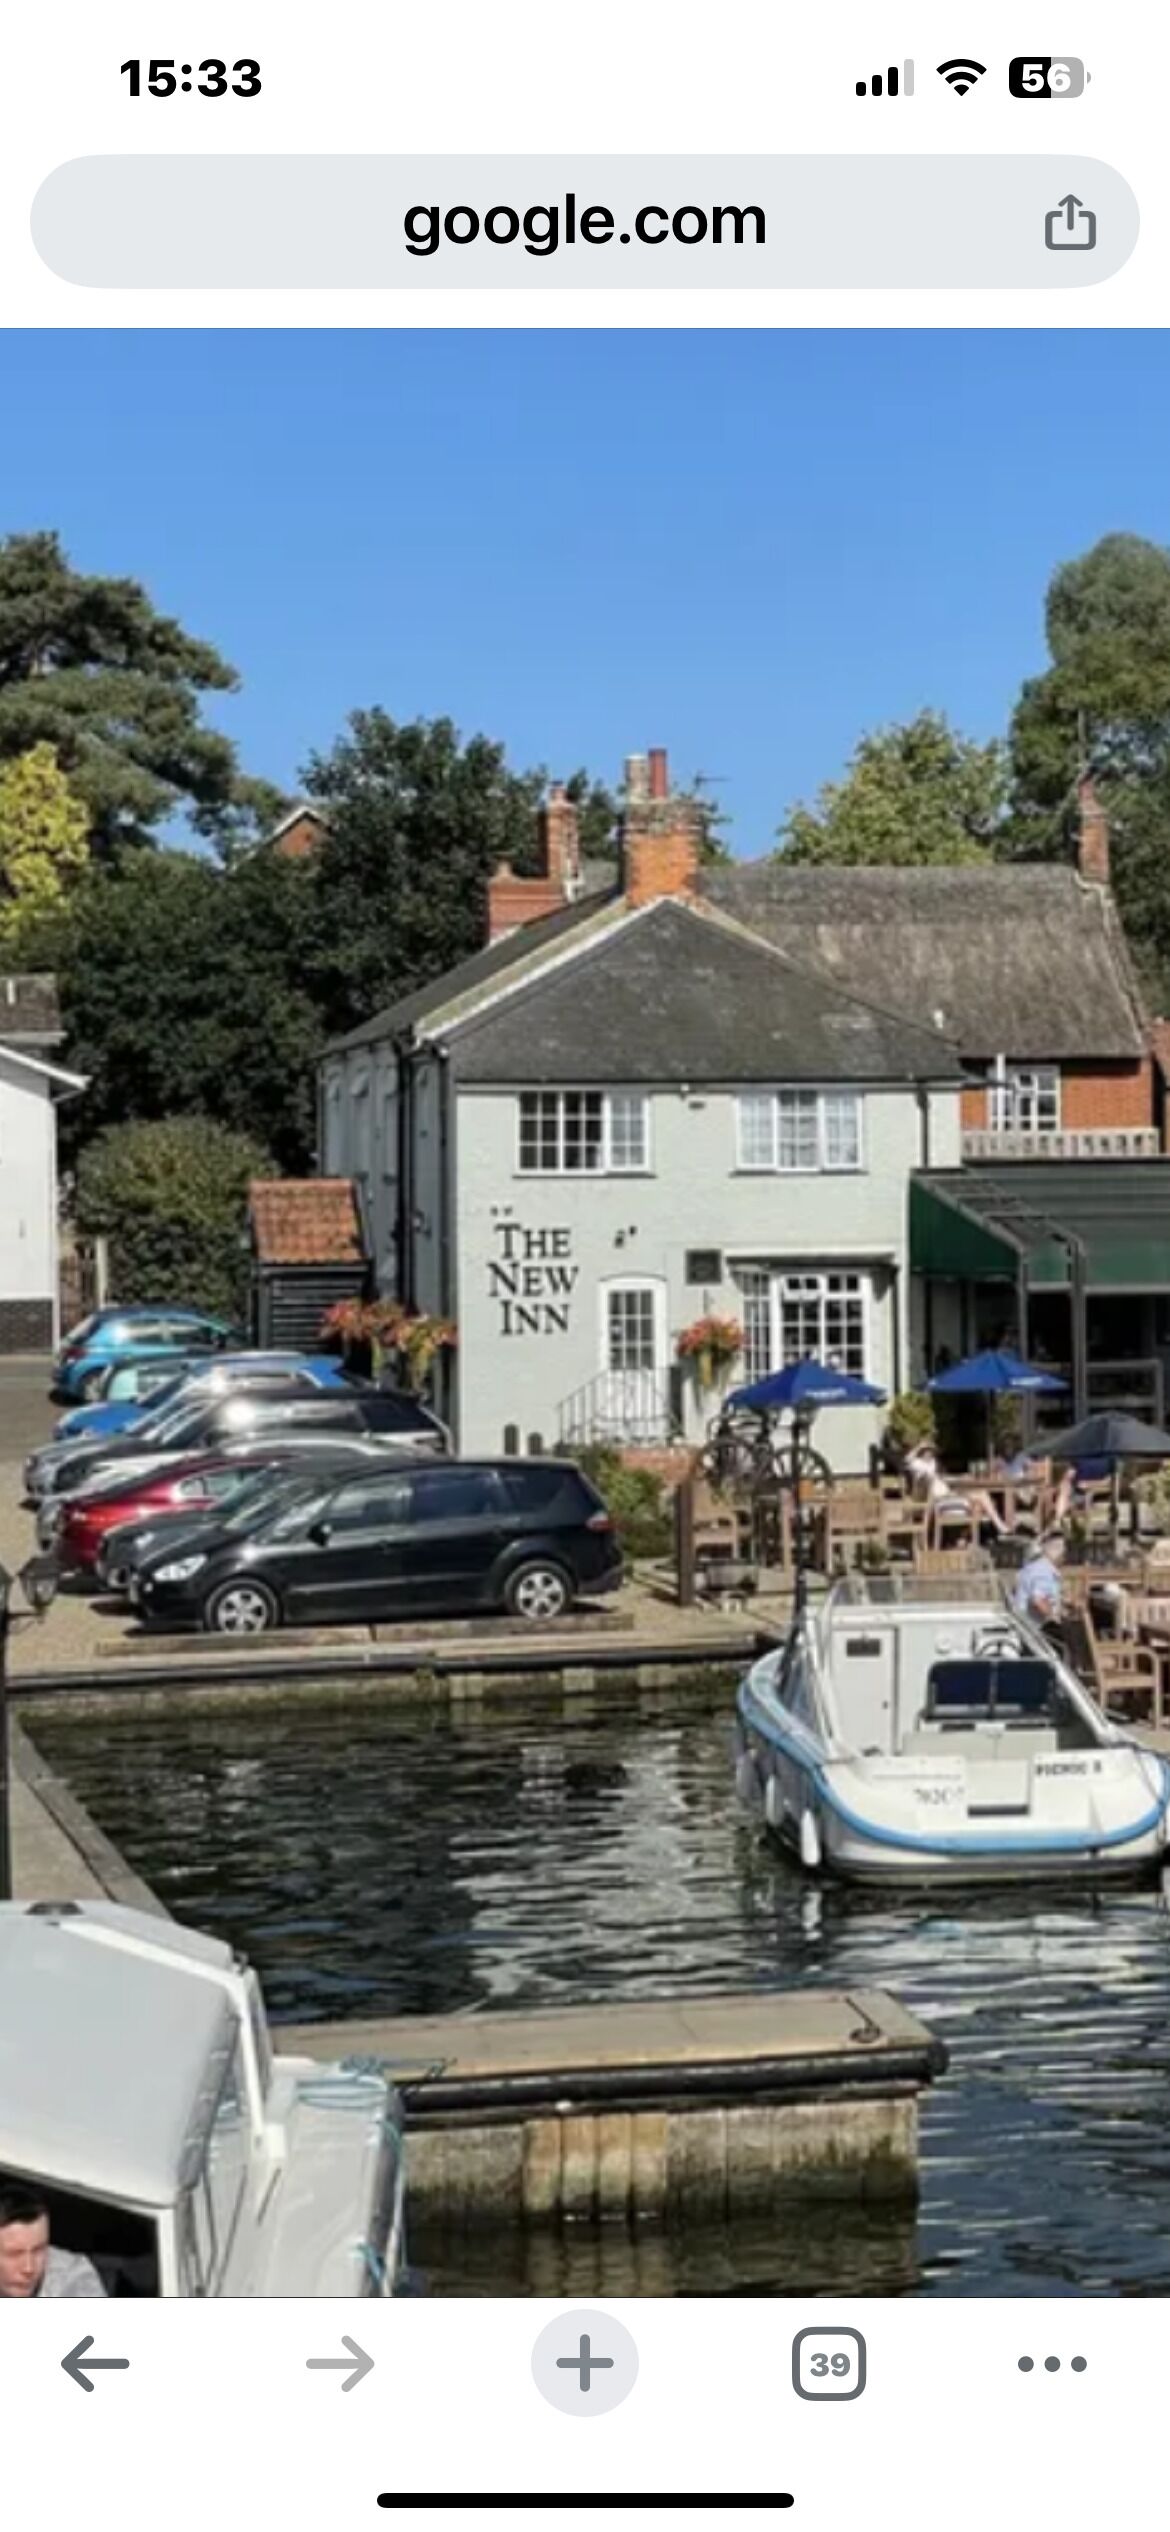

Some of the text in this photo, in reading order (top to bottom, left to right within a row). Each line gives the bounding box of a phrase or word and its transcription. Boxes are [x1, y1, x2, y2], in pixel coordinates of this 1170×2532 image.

[120, 59, 262, 97] 15:33
[1022, 63, 1071, 92] 56
[403, 193, 766, 256] google.com
[494, 1222, 570, 1259] THE
[487, 1261, 578, 1297] NEW
[500, 1299, 569, 1336] INN
[810, 2353, 851, 2377] 39
